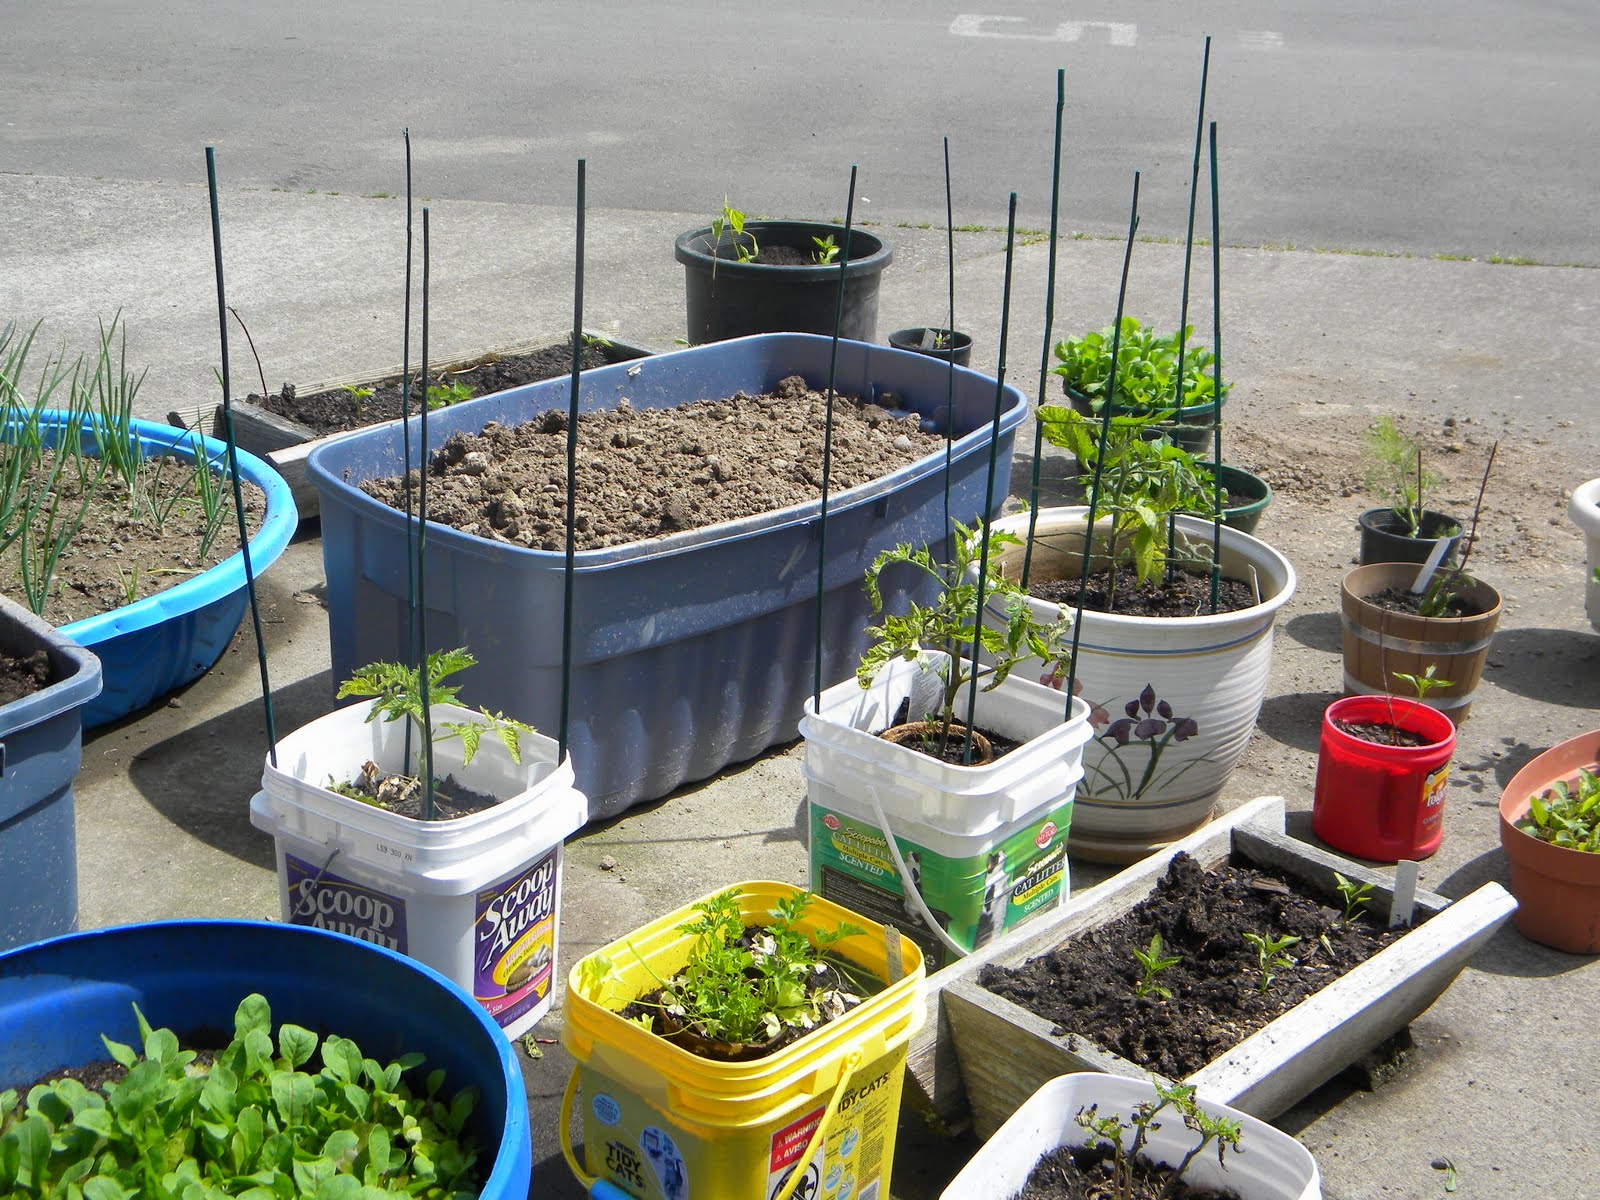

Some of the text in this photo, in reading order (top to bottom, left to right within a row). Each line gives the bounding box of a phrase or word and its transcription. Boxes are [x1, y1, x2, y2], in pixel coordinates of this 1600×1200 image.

[832, 832, 895, 862] CAT LITTER
[842, 845, 868, 859] Multiple
[838, 852, 884, 876] SCENTED
[480, 858, 553, 941] Scoop
[1014, 875, 1035, 896] CAT
[1023, 888, 1054, 912] SCENTED
[296, 878, 393, 931] Scoop
[481, 883, 554, 972] Away
[837, 1091, 859, 1114] IDY
[859, 1071, 889, 1099] CATS
[605, 1140, 641, 1172] TIDY
[783, 1139, 809, 1158] AVISO
[605, 1156, 645, 1188] CATS
